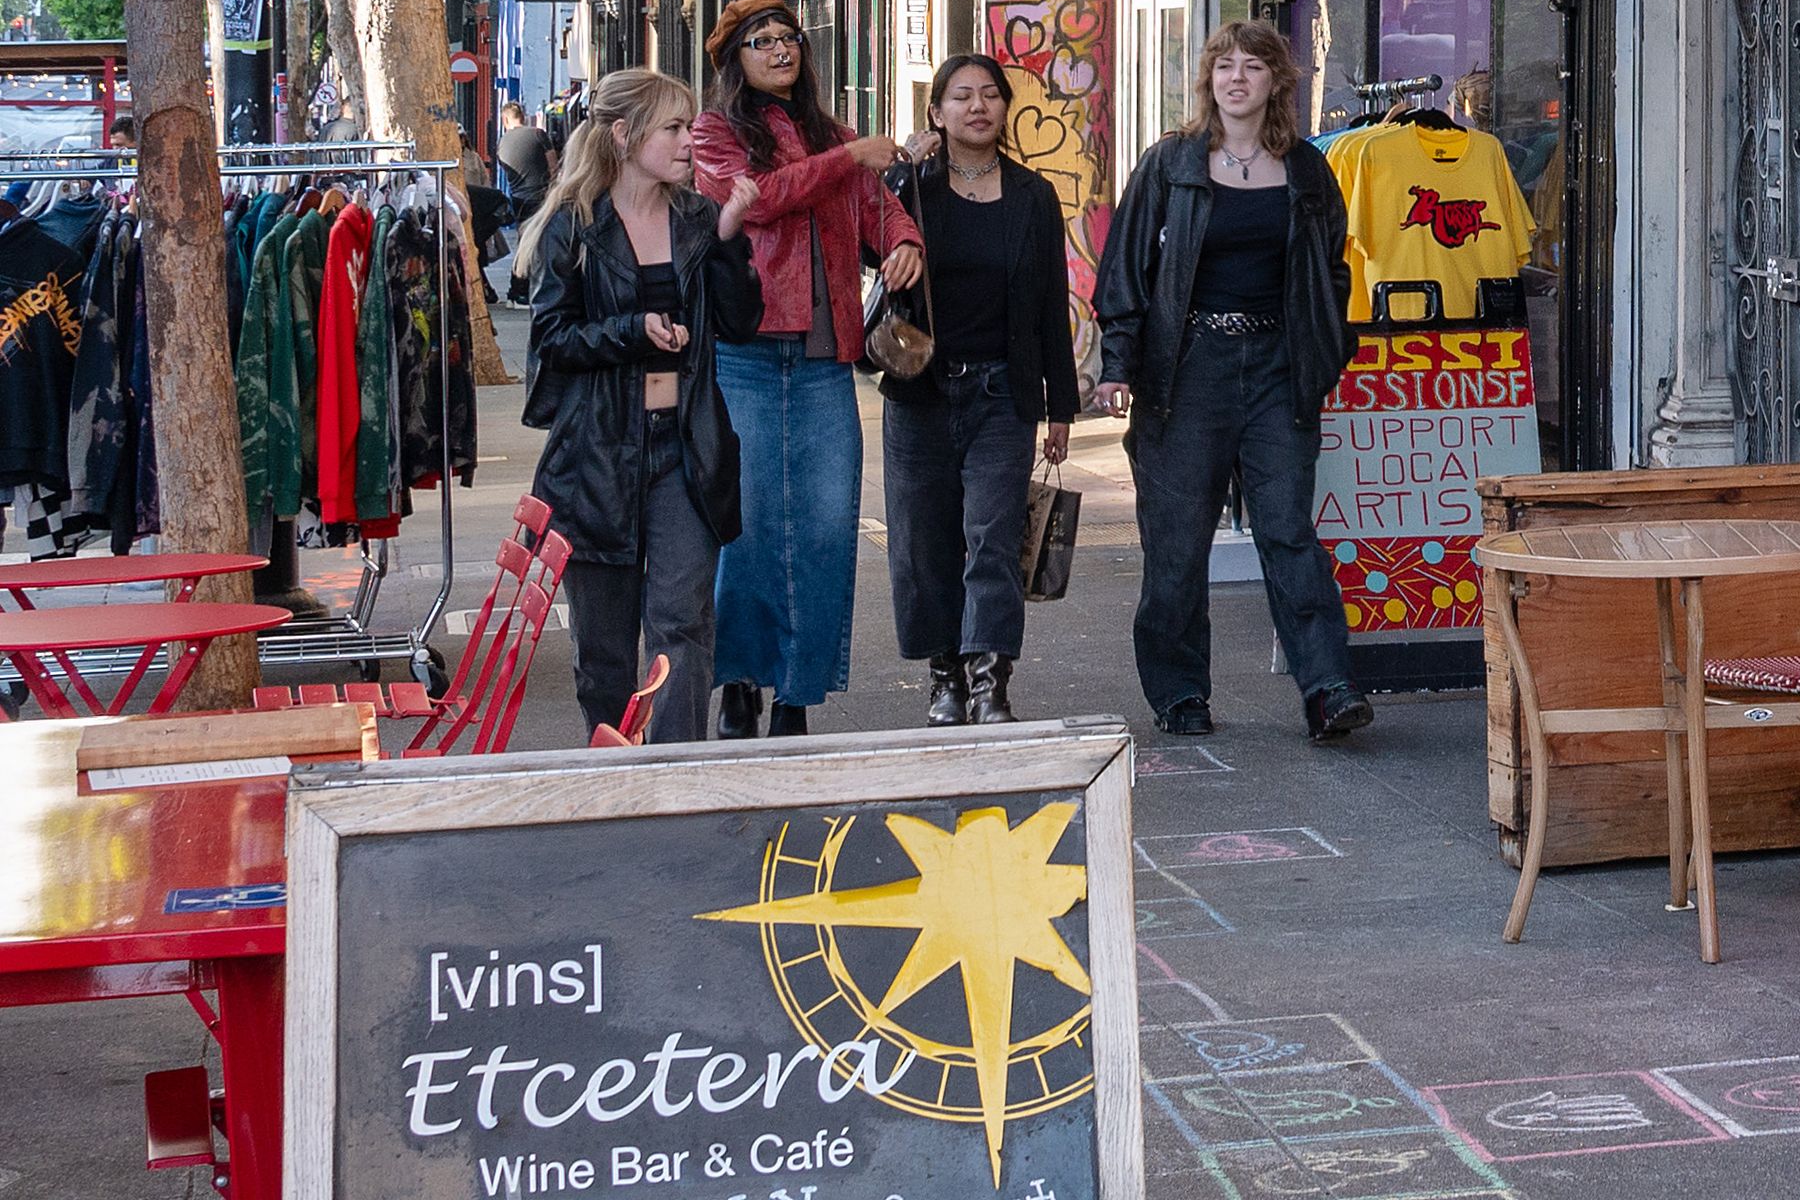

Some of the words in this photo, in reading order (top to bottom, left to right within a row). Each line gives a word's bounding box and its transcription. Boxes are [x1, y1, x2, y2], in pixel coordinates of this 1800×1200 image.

[1346, 332, 1525, 372] OSSI
[1324, 371, 1528, 411] ISSIONSF
[1320, 416, 1526, 451] SUPPORT
[1314, 489, 1472, 530] ARTIS
[431, 944, 602, 1022] [vins]
[402, 1031, 918, 1137] Etcetera
[480, 1152, 595, 1196] Wine
[611, 1145, 690, 1186] Bar
[703, 1142, 736, 1178] &
[749, 1125, 855, 1174] Café
